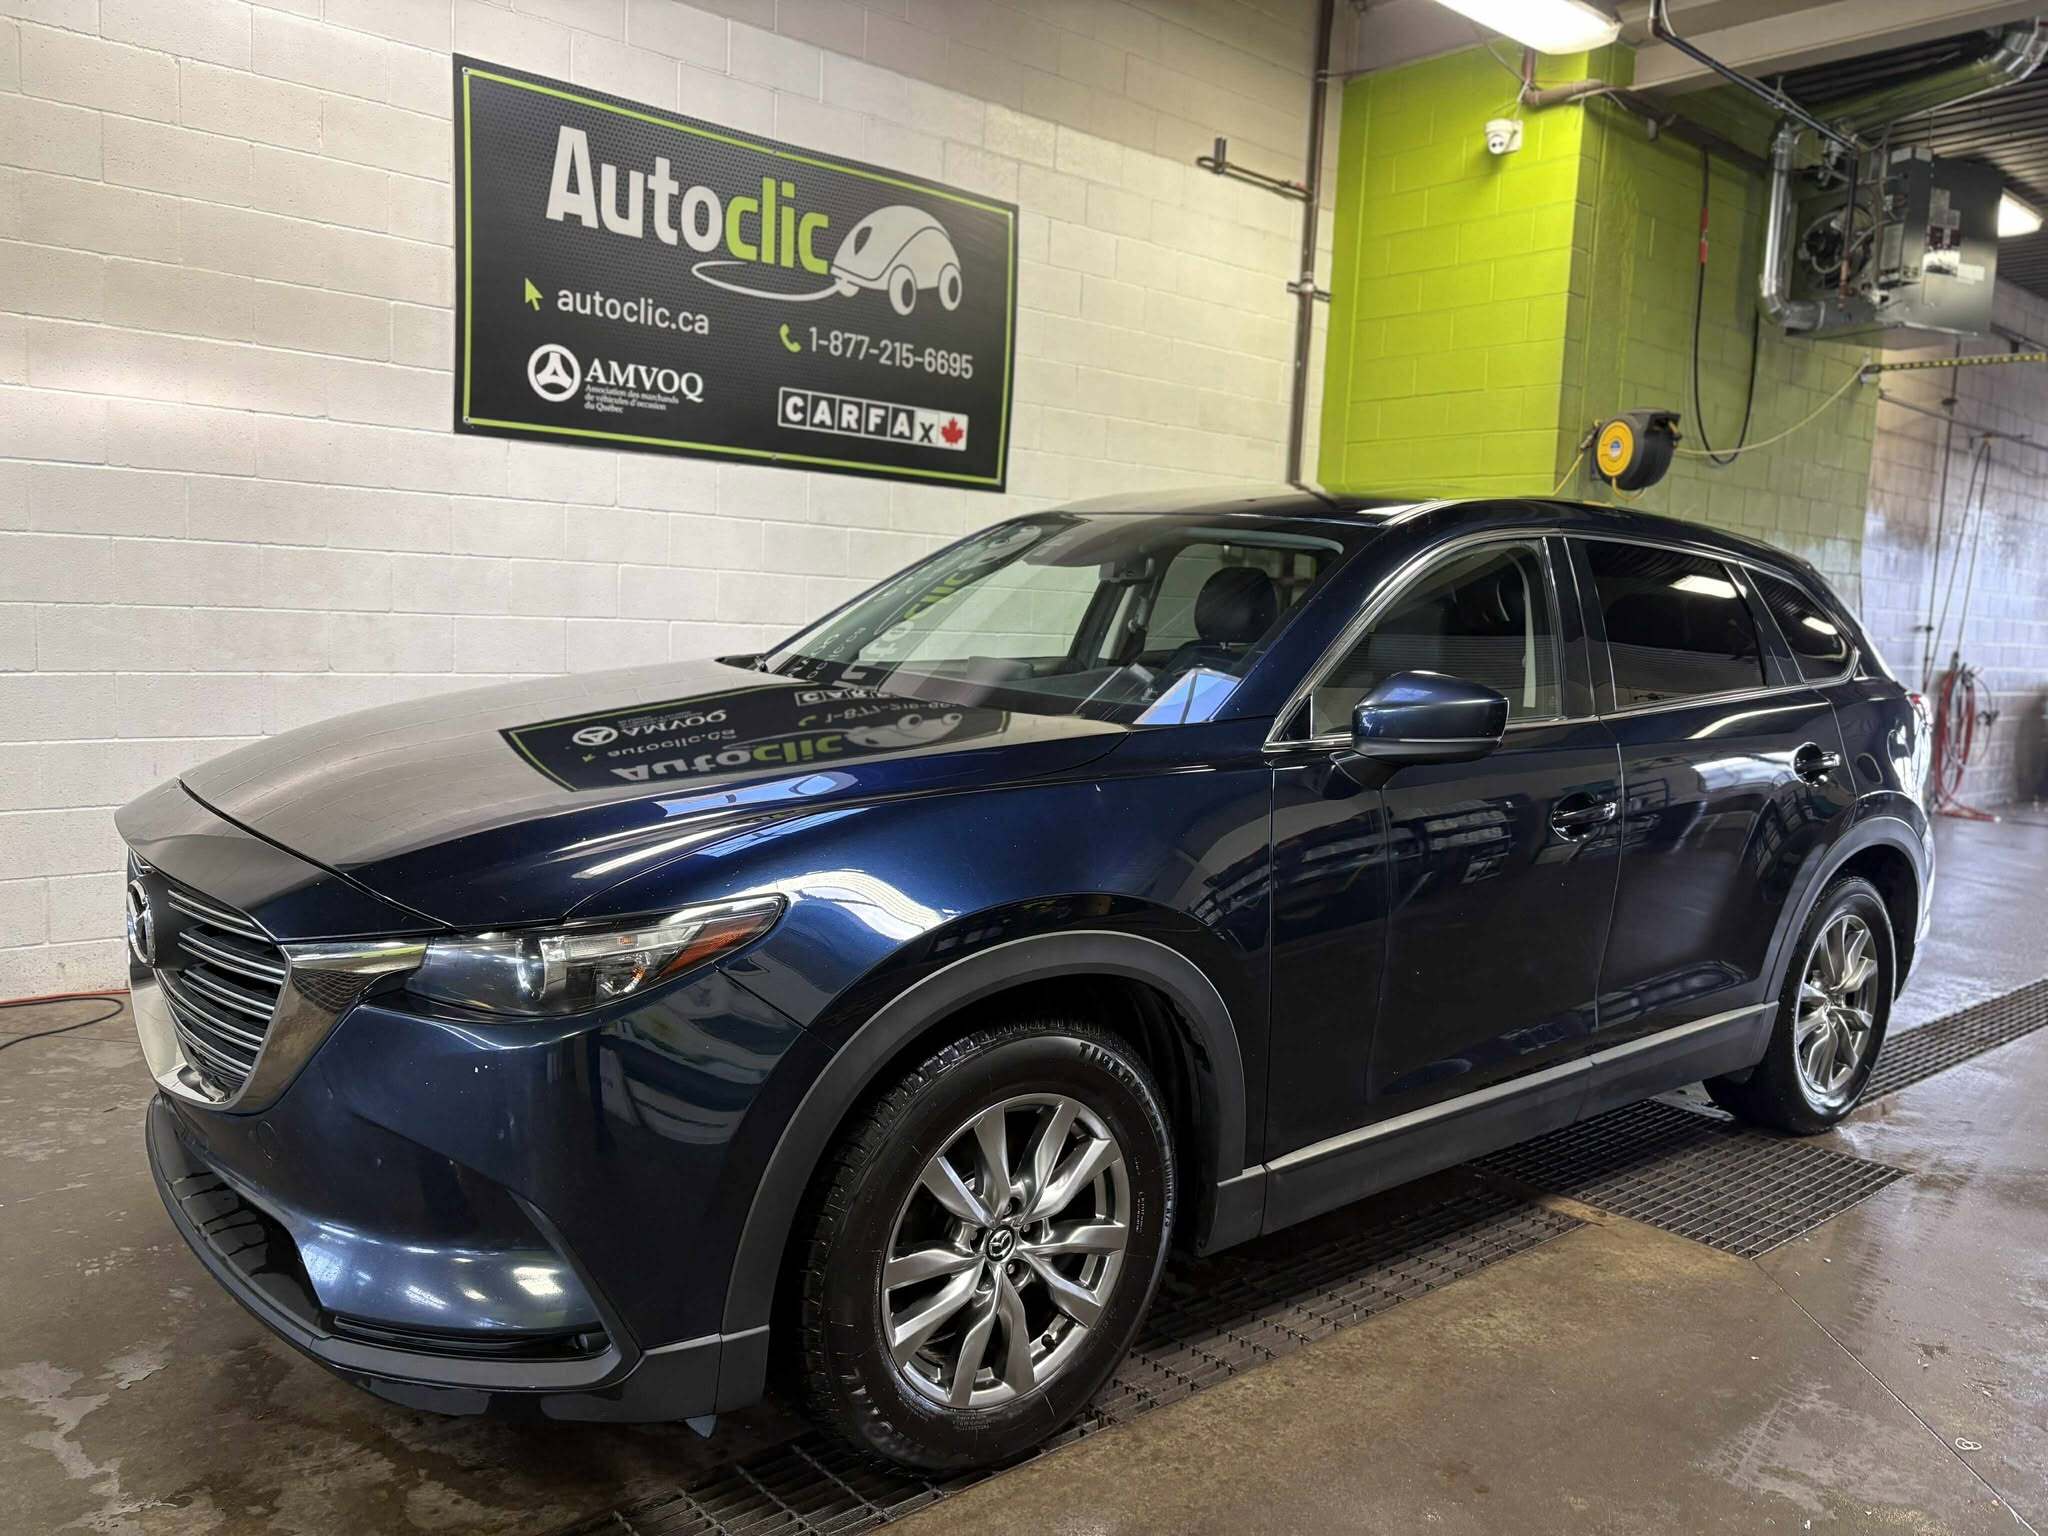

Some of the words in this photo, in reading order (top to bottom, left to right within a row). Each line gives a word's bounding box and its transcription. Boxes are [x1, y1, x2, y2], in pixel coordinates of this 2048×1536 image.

[546, 125, 830, 275] Autoclic
[557, 288, 710, 335] autoclic.ca
[809, 326, 974, 379] 1-877-215-6695
[584, 358, 704, 403] AMVOQ
[784, 395, 935, 444] CARFAX
